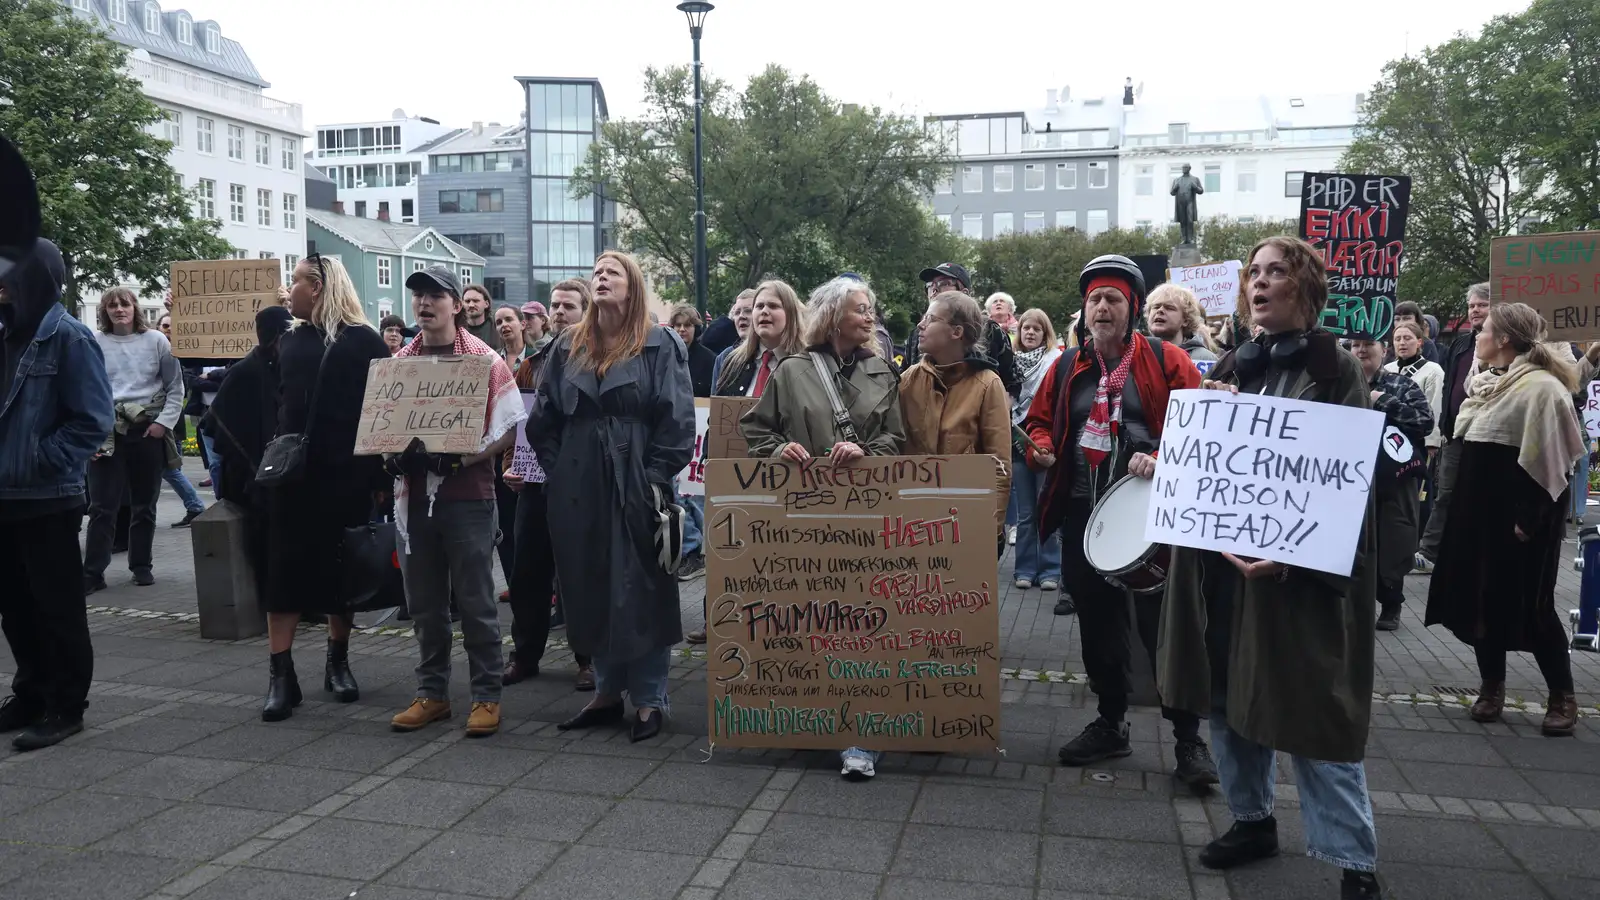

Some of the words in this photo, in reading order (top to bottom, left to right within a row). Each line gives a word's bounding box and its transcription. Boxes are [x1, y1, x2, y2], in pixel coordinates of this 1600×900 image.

[1362, 177, 1400, 209] ER
[1181, 265, 1228, 282] ICELAND
[1376, 278, 1398, 293] UM
[177, 299, 246, 316] WELCOME
[1199, 294, 1225, 309] OME
[1320, 293, 1394, 341] ERND
[1553, 306, 1588, 329] ERU
[177, 338, 200, 350] ERU
[375, 380, 404, 401] NO
[416, 380, 480, 398] HUMAN
[370, 410, 394, 433] IS
[405, 409, 475, 430] ILLEGAL
[1166, 398, 1222, 429] PUT
[1224, 401, 1306, 440] THE
[1156, 476, 1179, 498] IN
[1196, 476, 1311, 514] PRISON
[1155, 506, 1319, 554] INSTEAD!!
[806, 576, 847, 592] VERN
[908, 628, 963, 648] BAKA
[946, 642, 997, 660] TAFAR
[897, 659, 909, 678] &
[803, 686, 820, 696] UM
[940, 682, 985, 700] ERU
[838, 700, 853, 733] &
